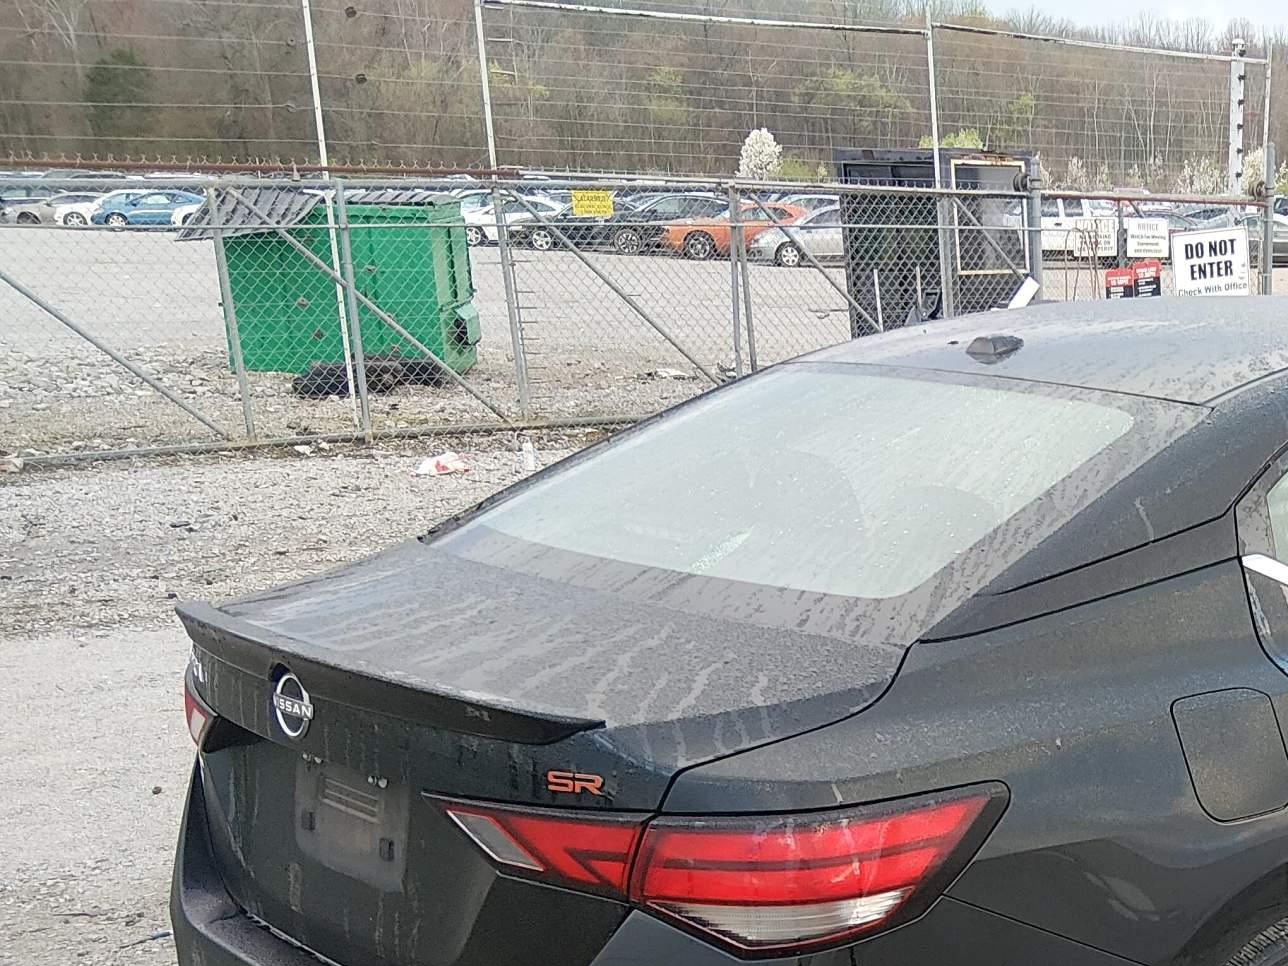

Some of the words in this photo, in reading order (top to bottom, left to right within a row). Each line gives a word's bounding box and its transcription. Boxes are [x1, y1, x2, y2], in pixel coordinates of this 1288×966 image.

[1184, 242, 1204, 259] DO
[1208, 238, 1236, 258] NOT
[1190, 260, 1234, 281] ENTER
[1204, 283, 1222, 294] With
[1225, 281, 1248, 291] Office
[546, 770, 605, 796] SR
